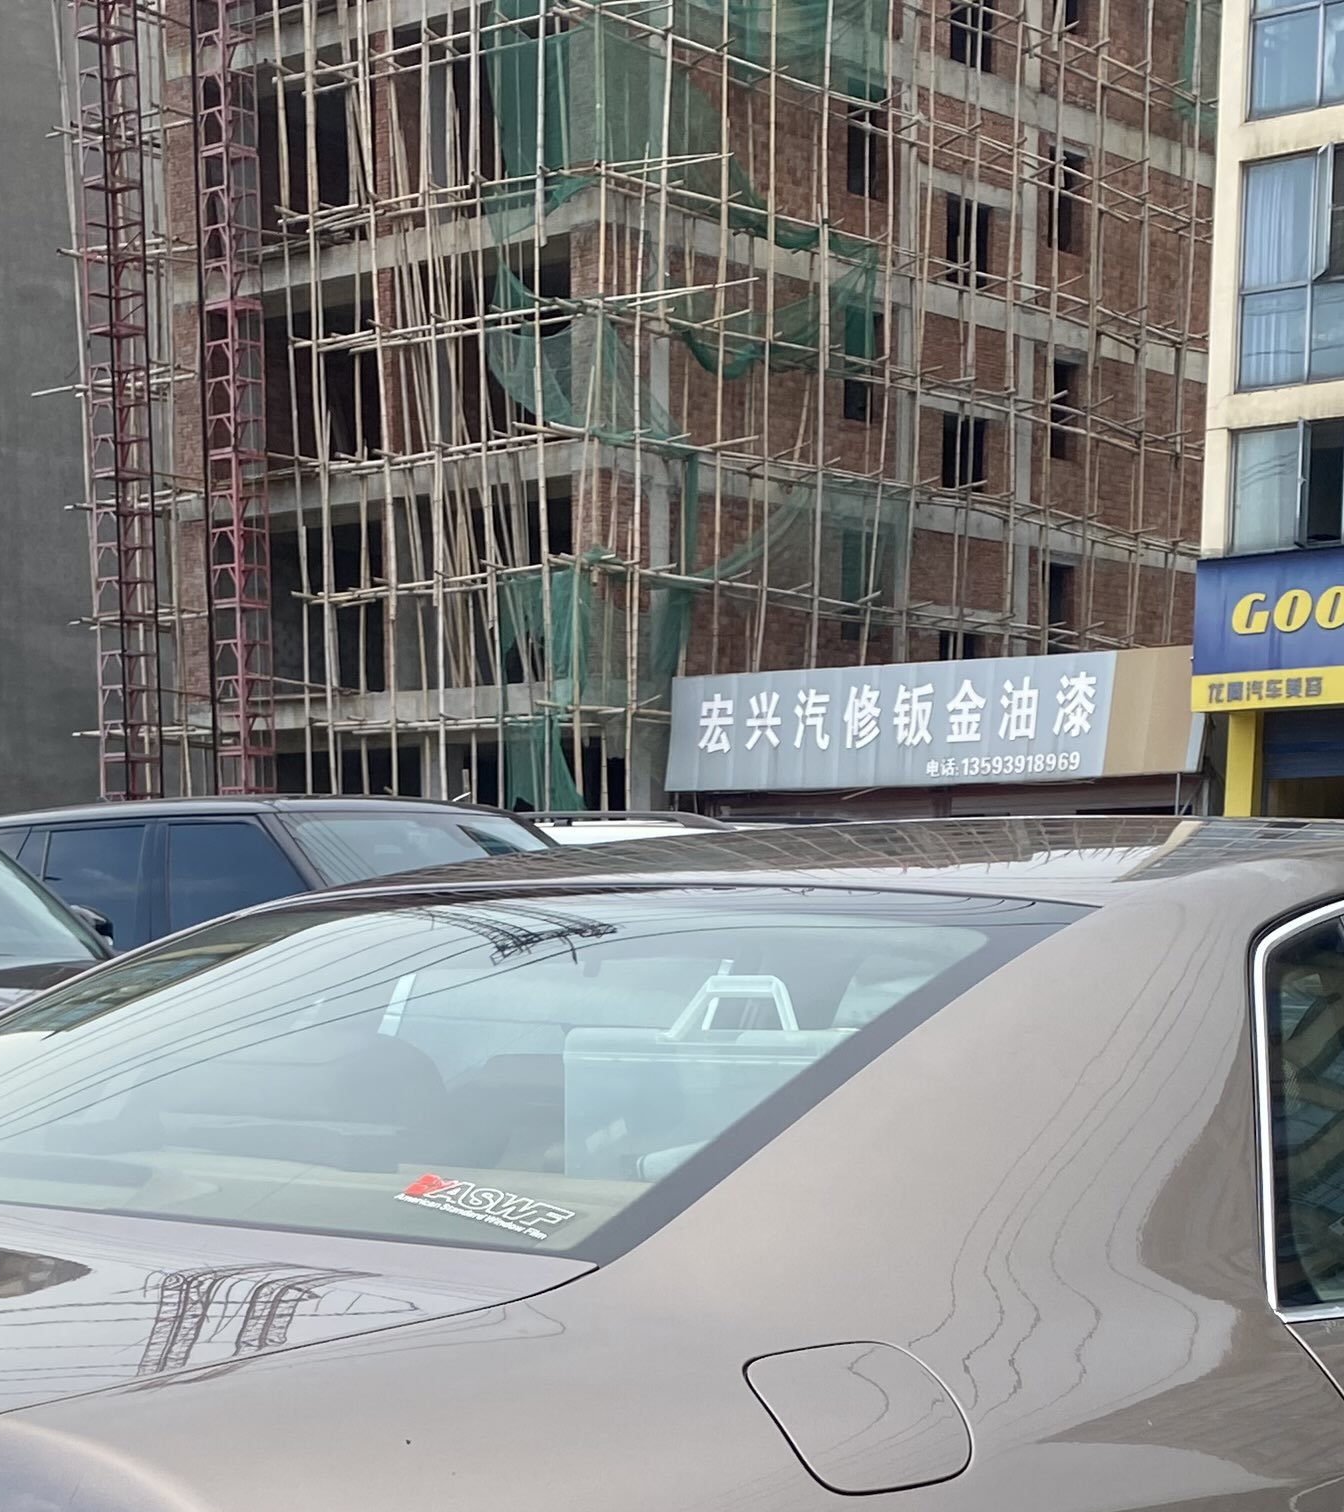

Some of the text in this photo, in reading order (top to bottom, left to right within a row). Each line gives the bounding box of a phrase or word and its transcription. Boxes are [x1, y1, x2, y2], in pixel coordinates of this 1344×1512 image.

[697, 671, 1098, 754] 宏兴汽修钣金油漆
[393, 1193, 548, 1240] American Standard Window Film
[423, 1180, 576, 1226] ASWF
